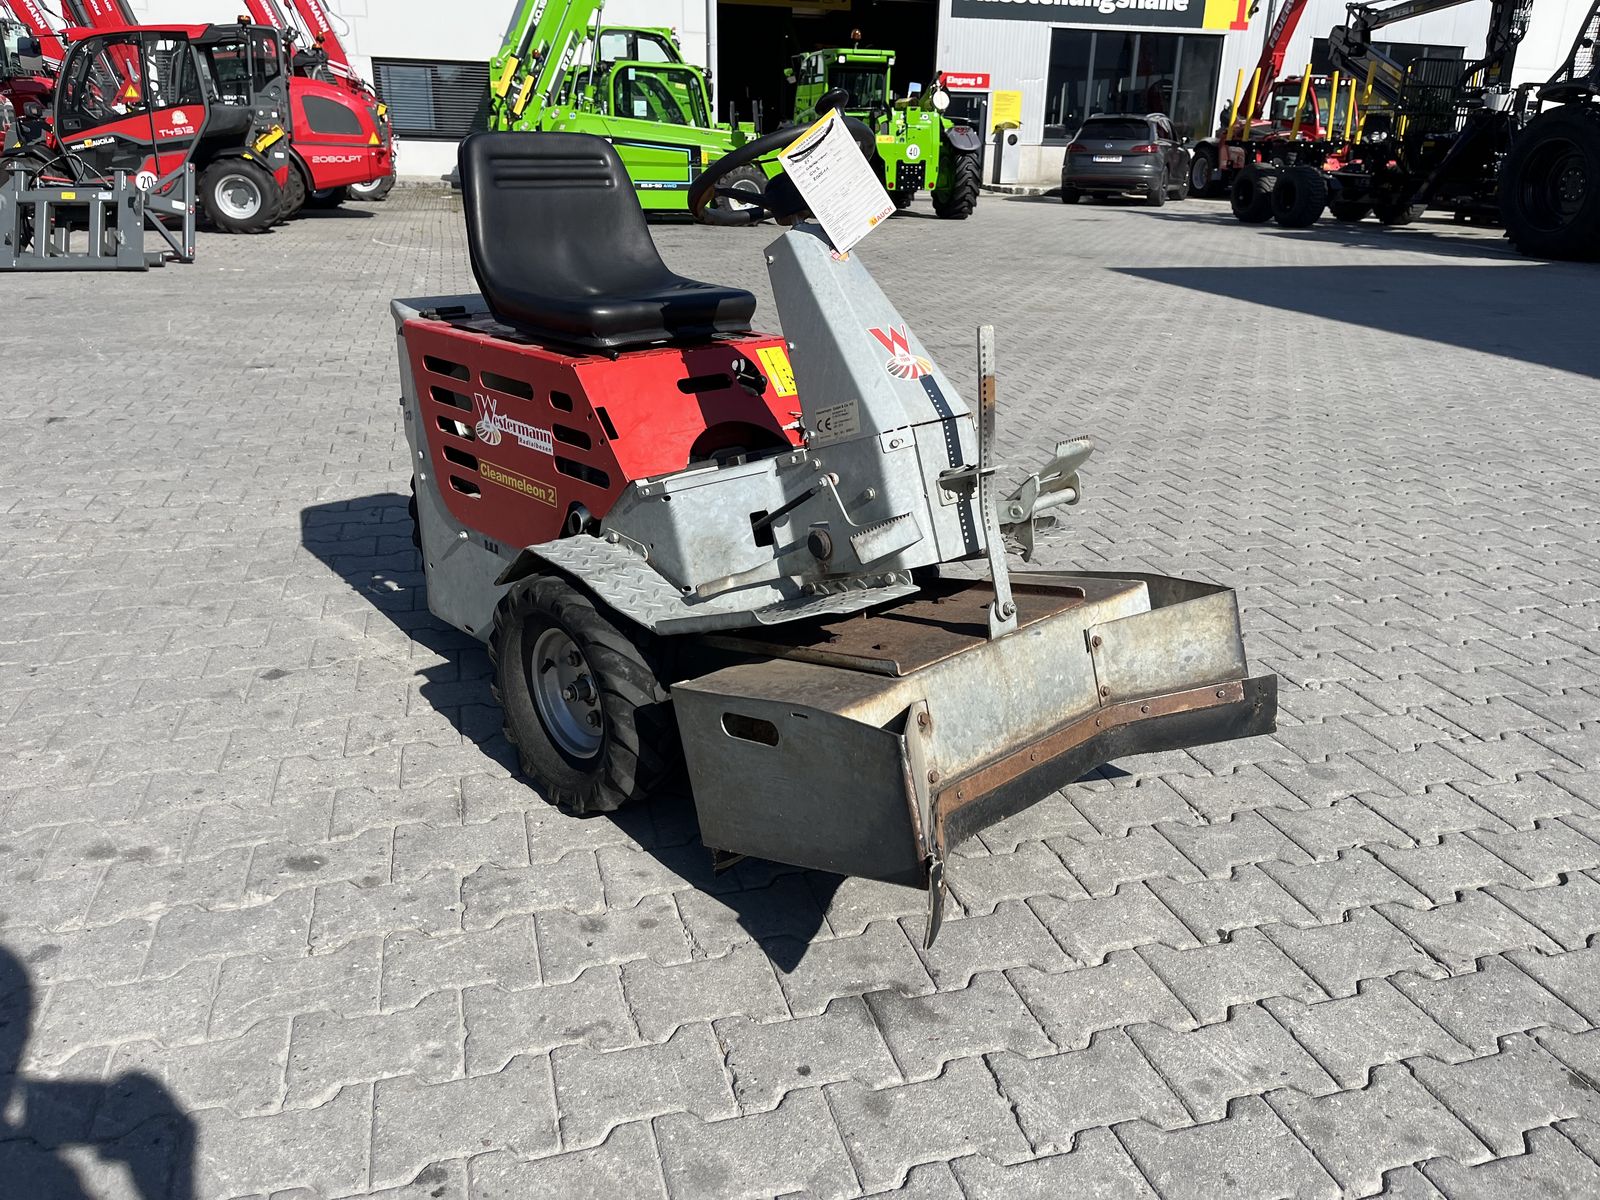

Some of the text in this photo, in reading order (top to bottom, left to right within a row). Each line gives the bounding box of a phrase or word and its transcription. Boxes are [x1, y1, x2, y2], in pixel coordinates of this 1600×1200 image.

[946, 75, 976, 86] Eingang
[158, 125, 195, 138] T4512
[908, 145, 919, 157] 40
[140, 175, 154, 190] 20
[474, 393, 552, 445] Westermann
[480, 463, 556, 504] Cleanmeleon 2
